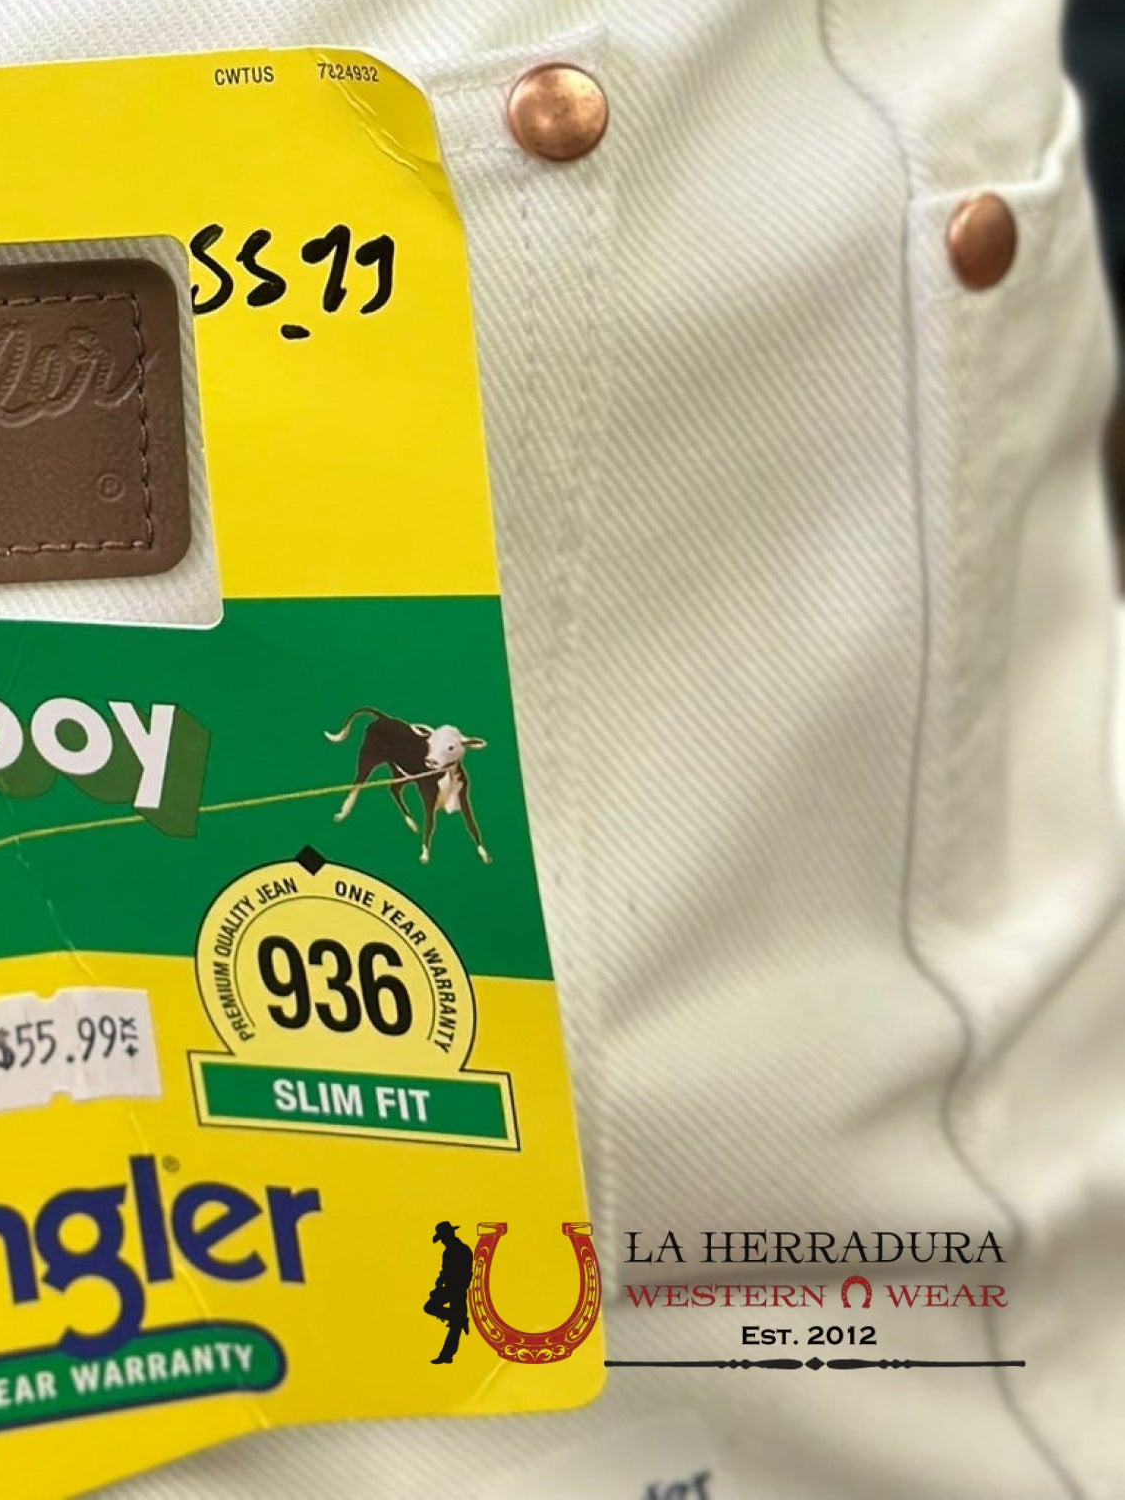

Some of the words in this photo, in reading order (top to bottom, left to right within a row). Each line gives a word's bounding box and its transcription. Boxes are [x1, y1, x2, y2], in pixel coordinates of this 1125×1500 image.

[215, 66, 275, 85] CWTUS
[256, 877, 299, 905] JEAN
[214, 895, 256, 958] QUALITY
[257, 935, 413, 1036] 936
[335, 881, 375, 908] ONE
[380, 900, 427, 946] YEAR
[422, 947, 458, 1054] WARRANTY
[213, 961, 256, 1042] PREMIUM
[273, 1079, 364, 1118] SLIM
[375, 1087, 431, 1123] FIT
[70, 1341, 254, 1395] WARRANTY
